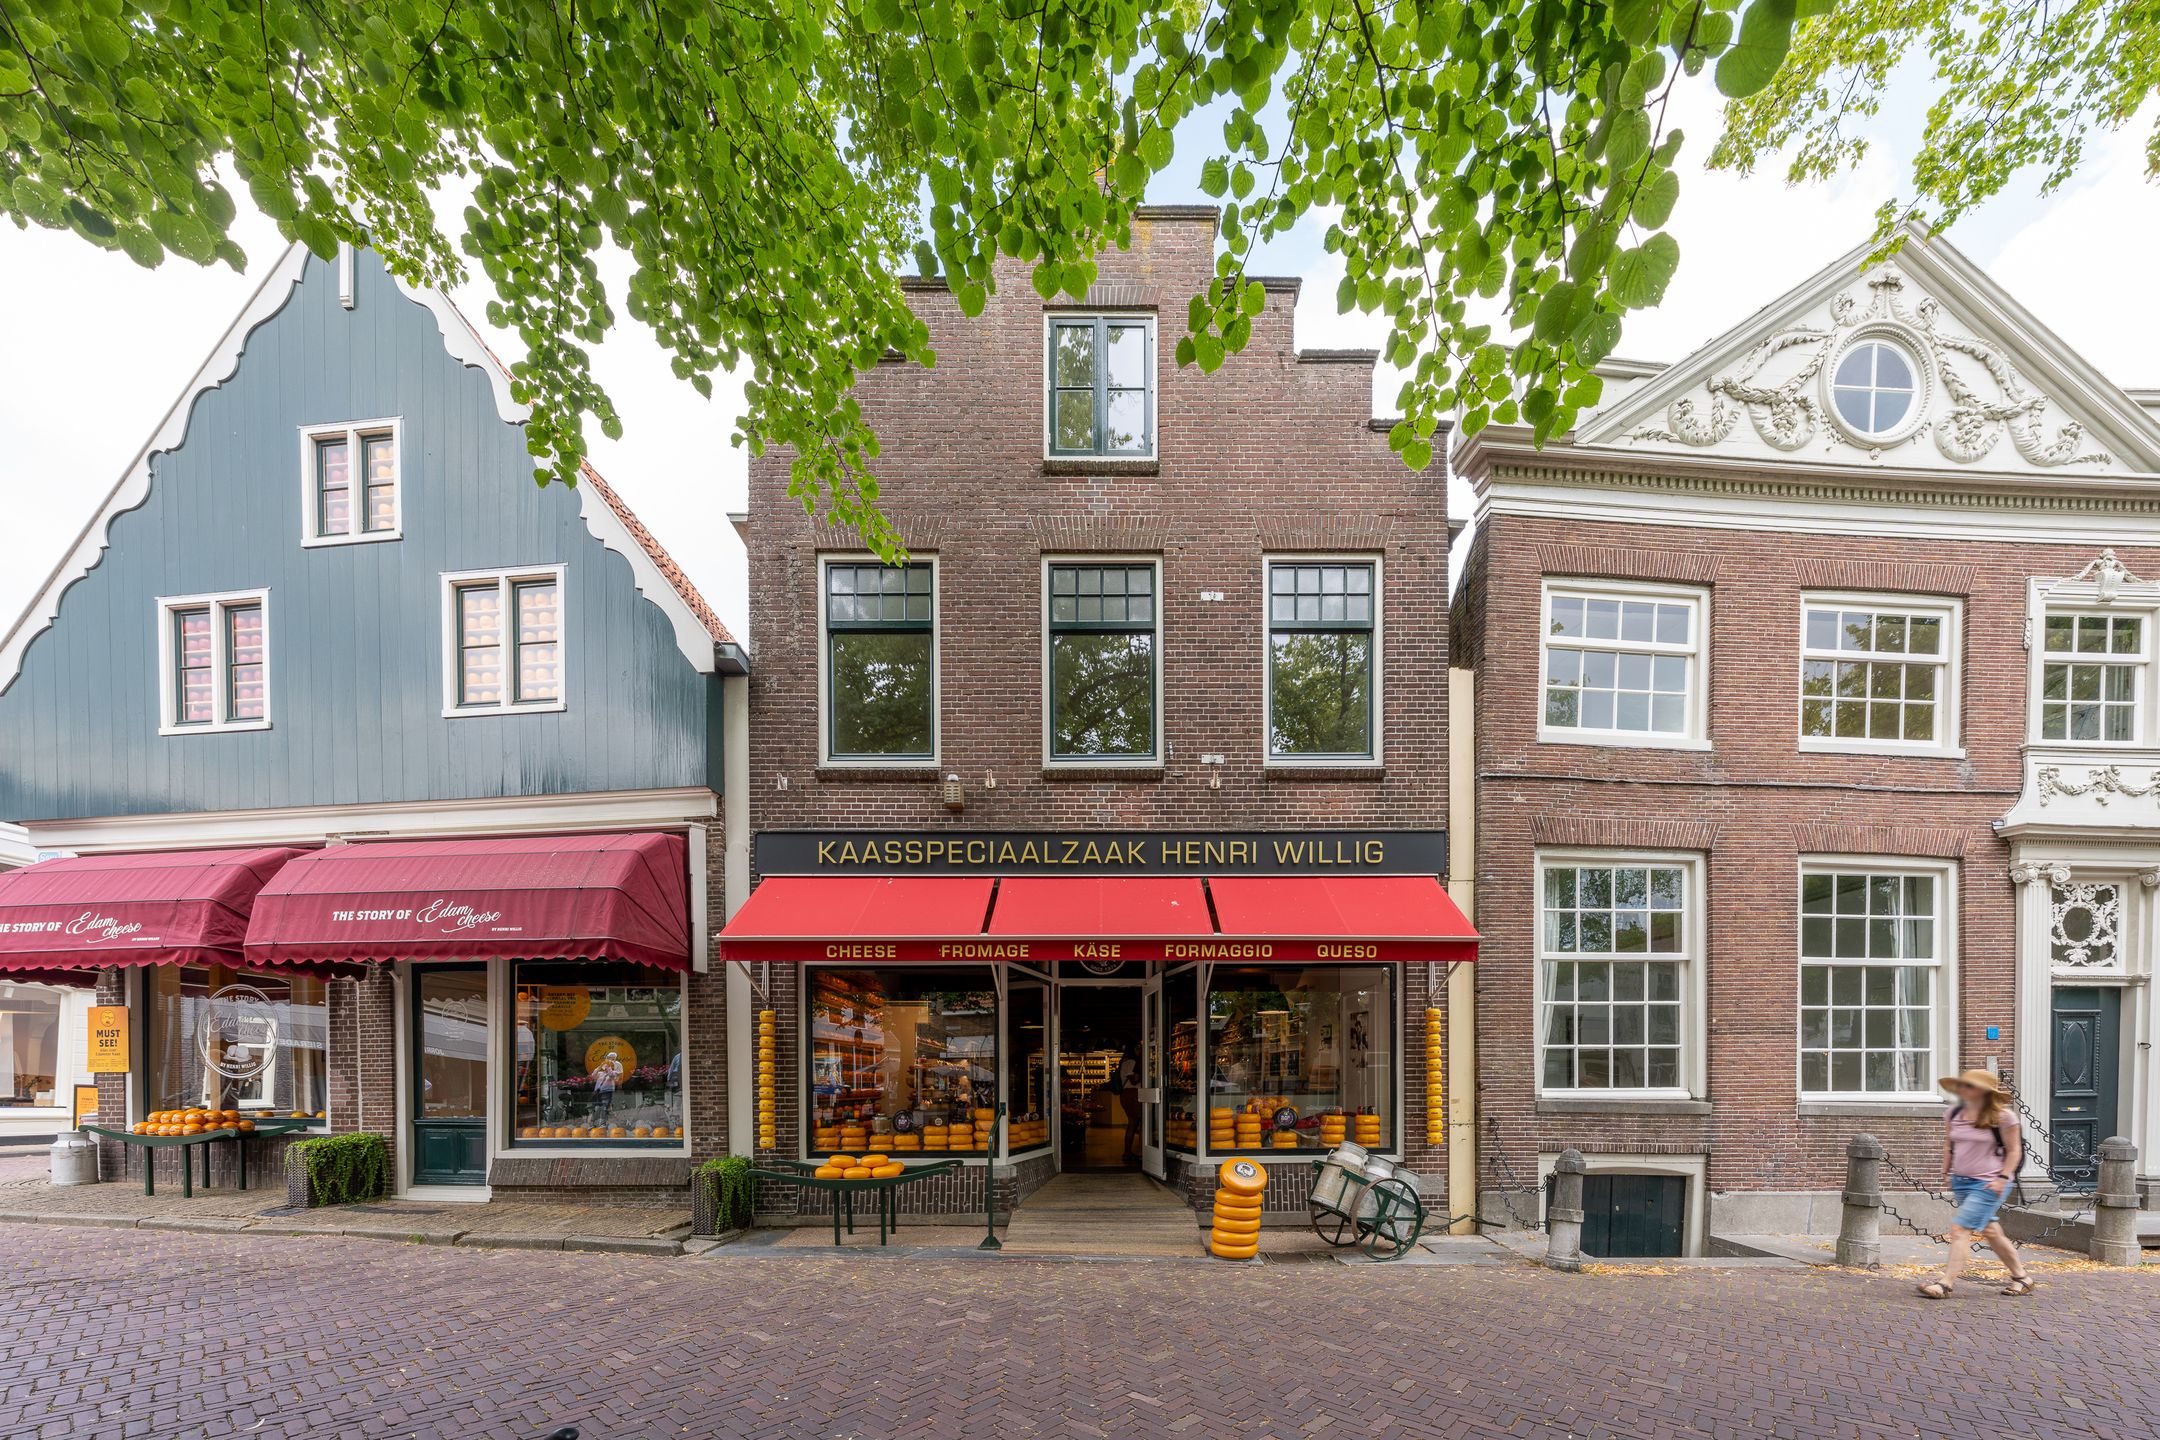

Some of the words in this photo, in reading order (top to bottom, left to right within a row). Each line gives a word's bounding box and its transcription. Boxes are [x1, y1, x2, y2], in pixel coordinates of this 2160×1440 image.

[818, 840, 1147, 864] KAASSPECIAALZAAK
[1161, 840, 1257, 864] HENRI
[1273, 840, 1385, 864] WILLIG
[332, 911, 355, 921] THE
[356, 910, 394, 921] STORY
[395, 909, 412, 920] OF
[416, 899, 470, 923] Edam
[12, 922, 47, 933] STORY
[47, 922, 63, 932] OF
[65, 911, 114, 934] Edam
[826, 945, 897, 958] CHEESE
[941, 945, 1030, 958] FROMAGE
[1074, 942, 1121, 958] KÄSE
[1165, 944, 1273, 958] FORMAGGIO
[1317, 945, 1377, 958] QUESO
[235, 995, 260, 1003] STORY
[96, 1029, 121, 1038] MUST
[99, 1038, 118, 1047] SEE!
